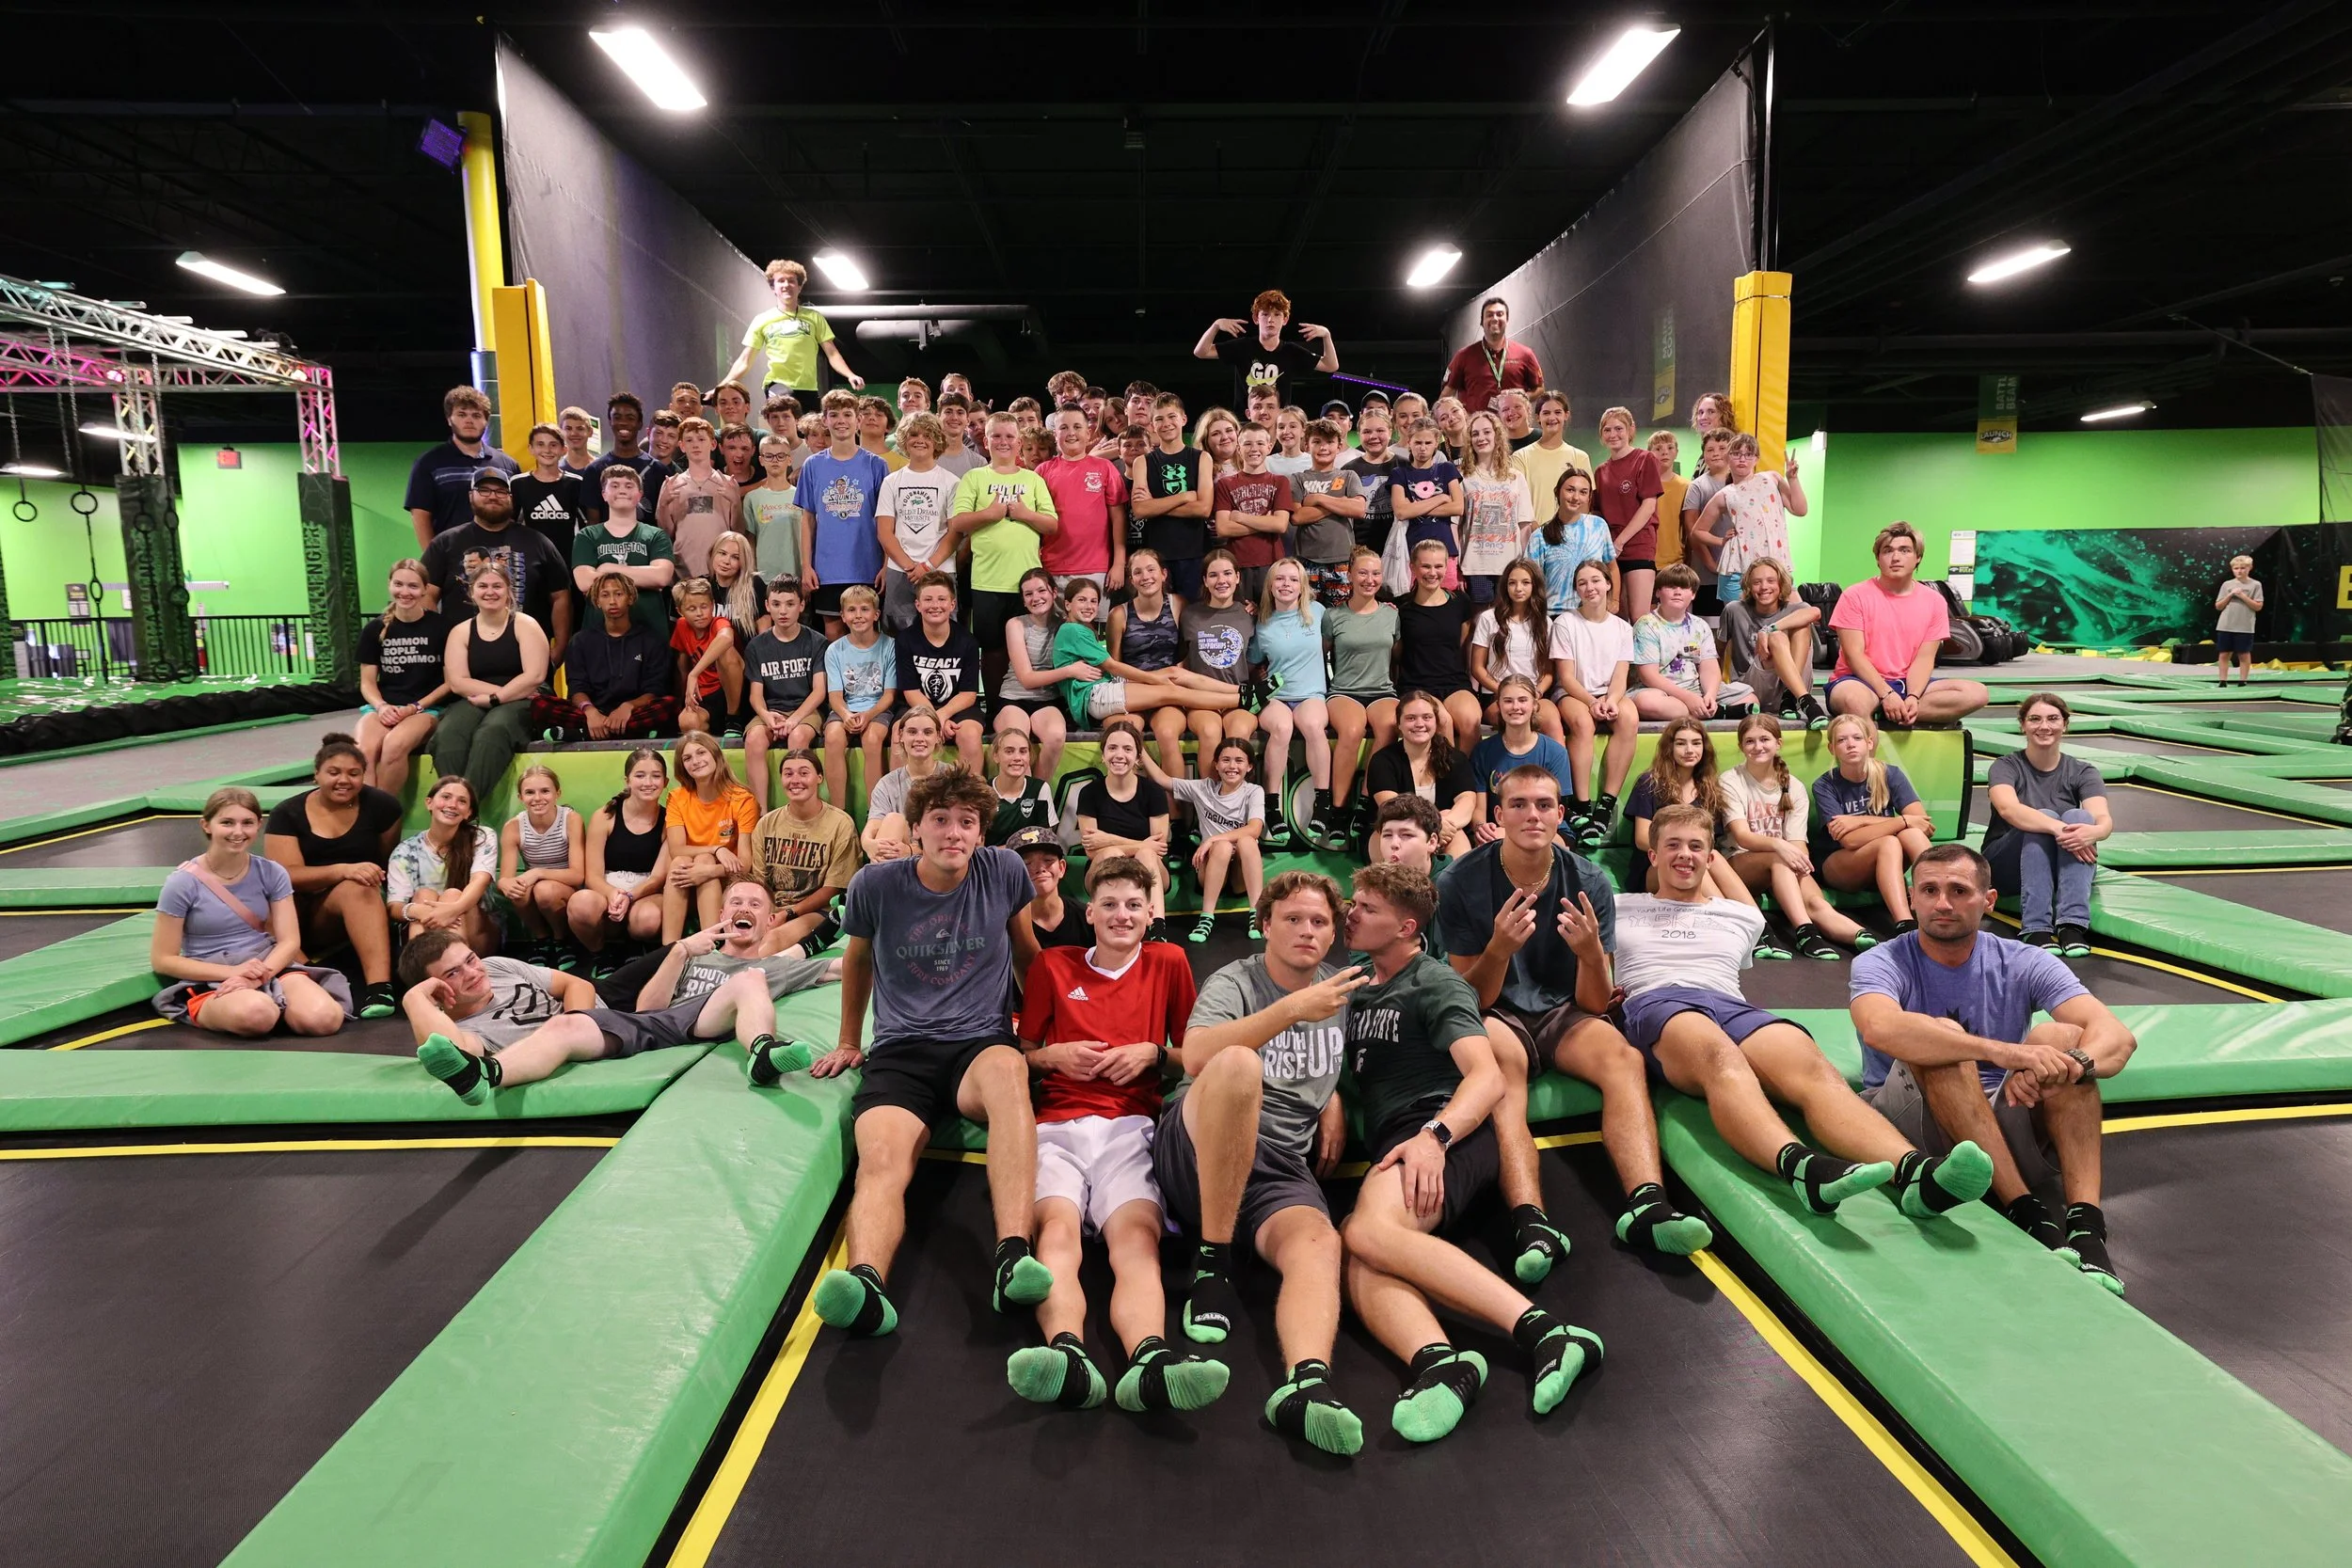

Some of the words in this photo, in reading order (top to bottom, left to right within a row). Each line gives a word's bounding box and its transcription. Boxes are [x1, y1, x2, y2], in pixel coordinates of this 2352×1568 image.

[1251, 362, 1279, 386] GO
[1995, 375, 2007, 410] BATTL
[2006, 376, 2017, 410] BEAM
[1980, 429, 2013, 439] LAUNCH
[988, 483, 1011, 496] PUT
[1012, 483, 1025, 495] IN
[1303, 480, 1332, 494] NIKE
[829, 494, 858, 503] SQUINTS
[903, 490, 933, 508] TOURNAMENTS
[531, 510, 570, 519] adidas
[381, 637, 429, 647] OMMON
[384, 646, 420, 657] EOPLE.
[761, 660, 781, 677] AIR
[913, 655, 961, 669] LEGACY
[764, 836, 827, 868] ENEMIES
[1654, 914, 1690, 928] 5K
[1661, 929, 1696, 940] 2018
[896, 936, 987, 959] QUIKSILVER
[692, 967, 730, 986] YOUTH
[907, 960, 929, 983] SURF
[929, 954, 977, 986] COMPANY
[684, 978, 716, 998] RIS
[1369, 1008, 1401, 1043] STATE
[1263, 1049, 1307, 1079] RISE
[1308, 1026, 1343, 1079] UP
